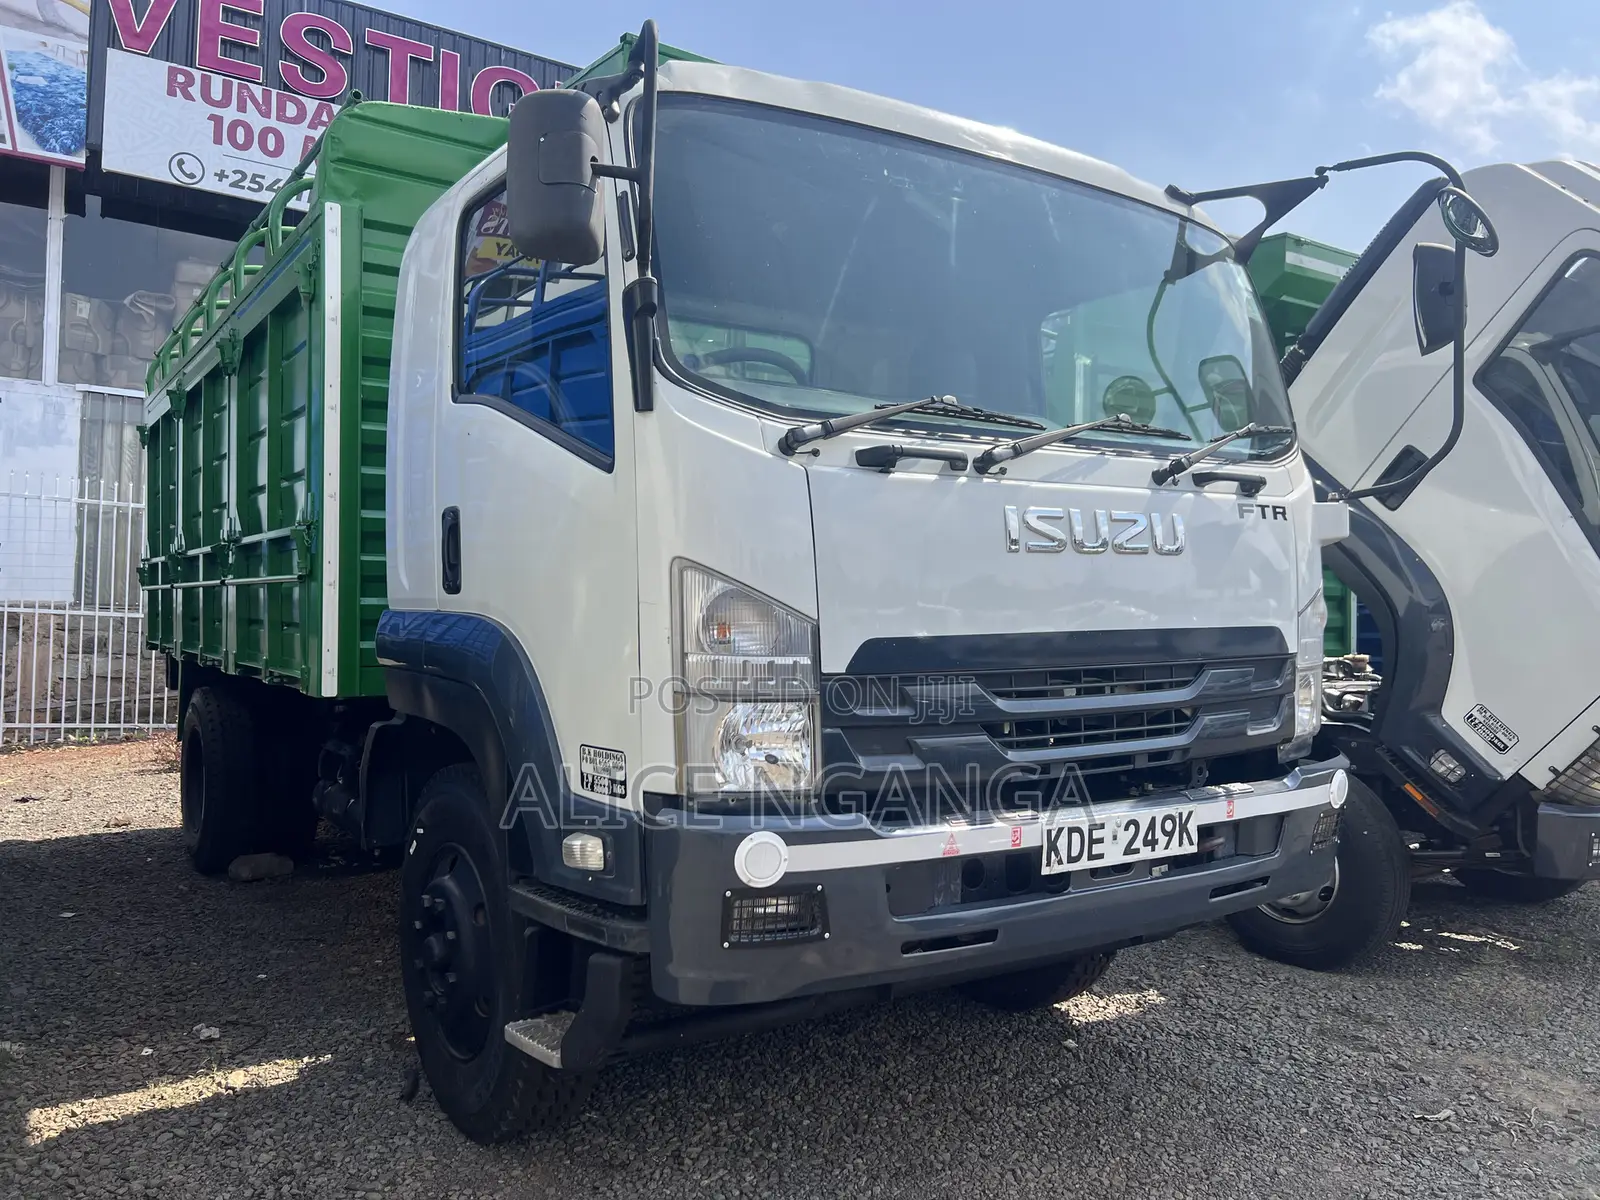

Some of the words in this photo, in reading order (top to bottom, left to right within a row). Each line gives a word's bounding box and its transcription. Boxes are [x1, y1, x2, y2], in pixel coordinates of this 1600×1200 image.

[207, 113, 285, 158] 100
[1004, 504, 1185, 555] ISUZU
[1237, 502, 1288, 521] FTR
[594, 749, 624, 762] HOLDINGS
[1045, 823, 1106, 867] KDE
[1123, 810, 1195, 856] 249K
